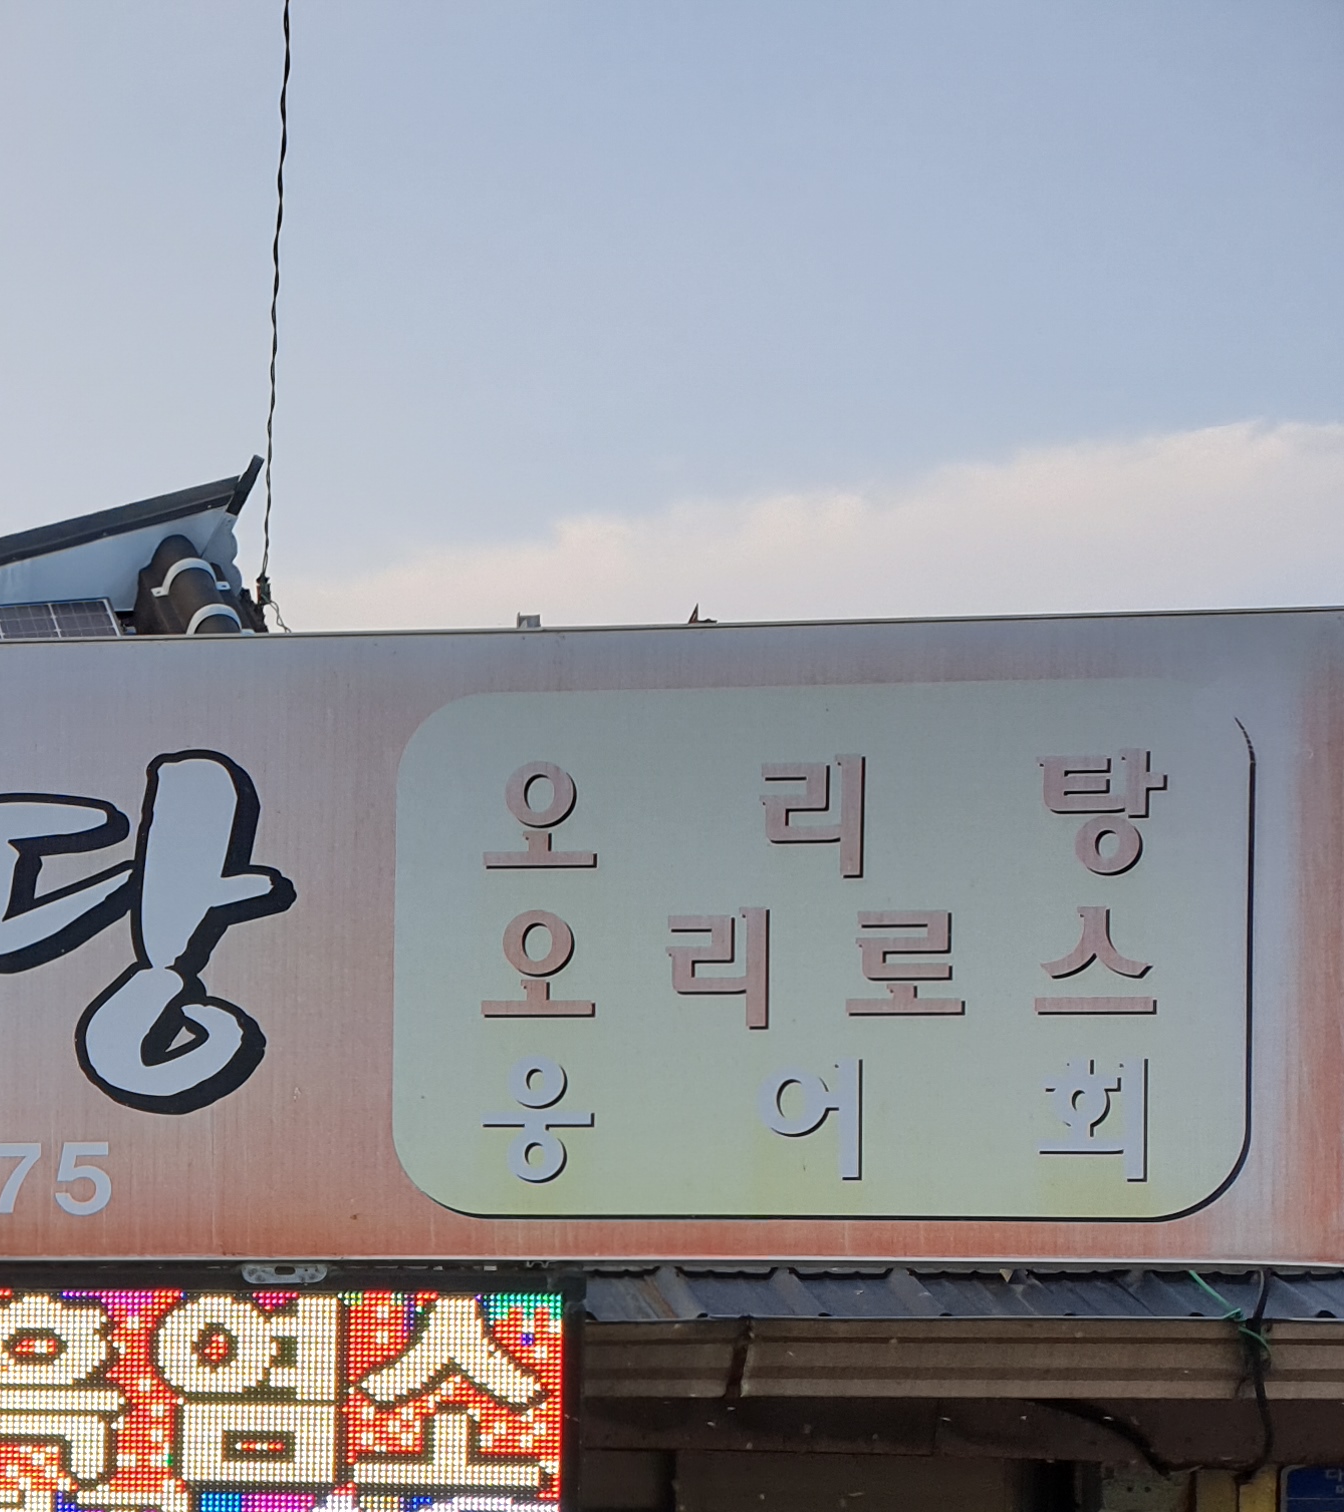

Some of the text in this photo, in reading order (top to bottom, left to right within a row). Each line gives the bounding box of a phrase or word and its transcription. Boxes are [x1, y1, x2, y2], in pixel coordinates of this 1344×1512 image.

[482, 748, 1169, 878] 오리탕
[480, 906, 1158, 1030] 오리로스
[482, 1056, 1150, 1183] 웅어회
